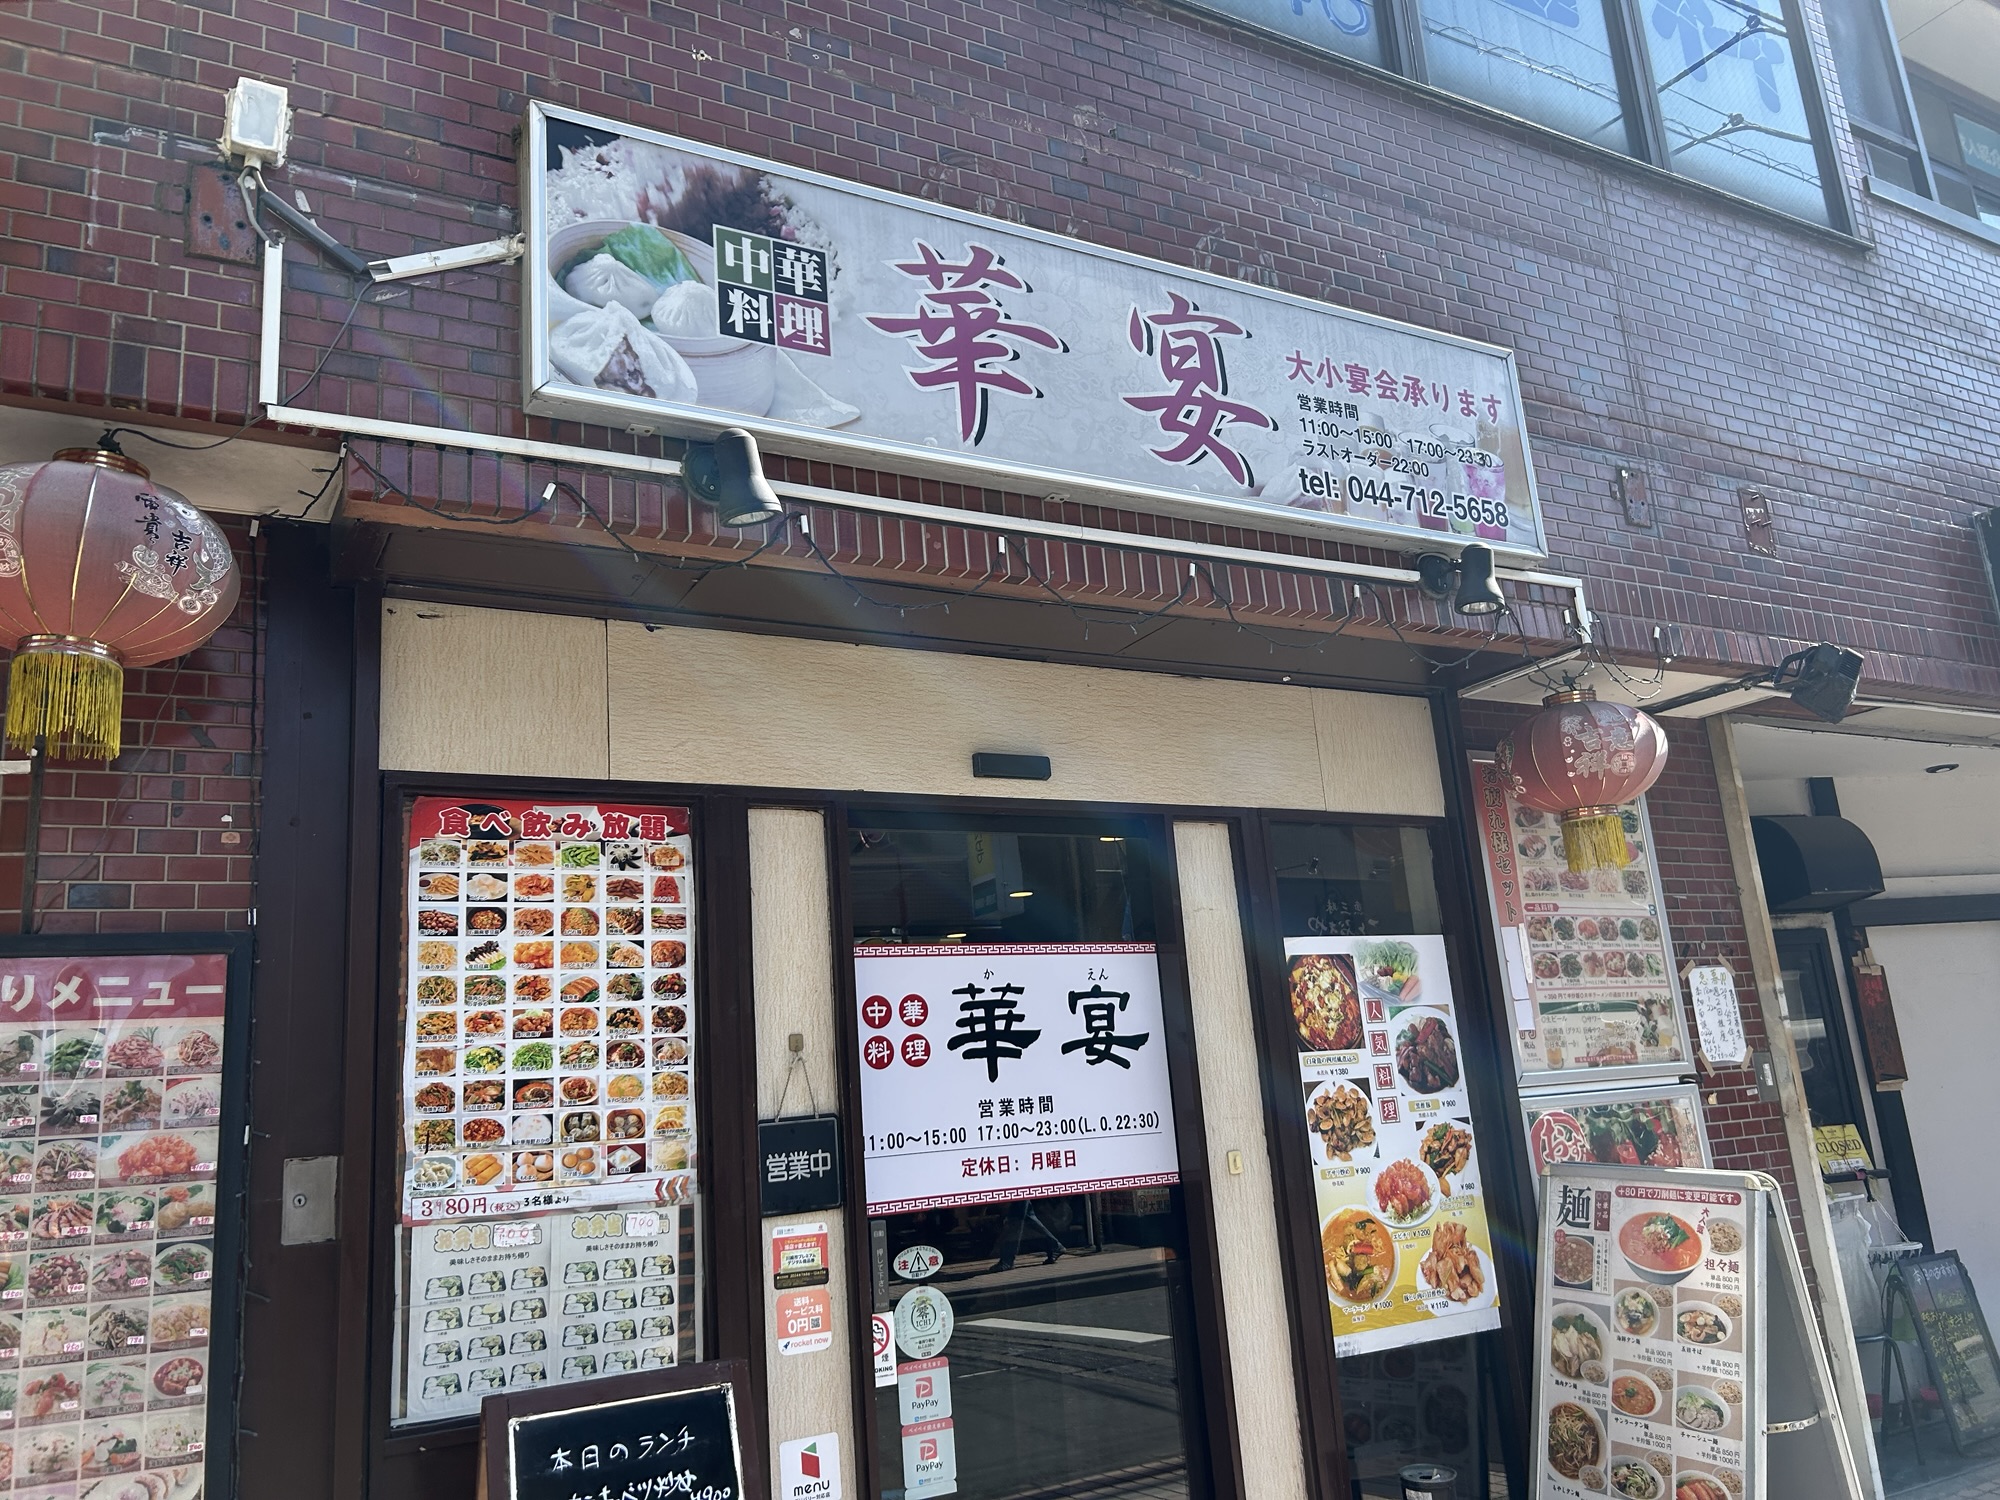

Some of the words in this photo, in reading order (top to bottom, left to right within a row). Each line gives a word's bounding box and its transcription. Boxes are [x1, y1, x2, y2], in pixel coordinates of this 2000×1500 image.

[725, 235, 823, 296] 中華
[726, 287, 825, 350] 料理
[1285, 350, 1503, 425] 大小宴会承ります
[1296, 393, 1360, 422] 営業時間
[1302, 439, 1429, 478] ラストオーダー22:00
[1299, 468, 1340, 499] tel:
[1348, 474, 1510, 528] 044-712-5658
[438, 806, 669, 842] 食べ飲み放題
[1481, 763, 1519, 924] お疲れ様セット
[1527, 903, 1554, 912] 一品料理
[983, 968, 995, 980] か
[1087, 968, 1109, 981] えん
[865, 999, 925, 1025] 中華
[867, 1038, 929, 1064] 料理
[1370, 1002, 1398, 1119] 人気料理
[1330, 1067, 1349, 1076] ¥1380
[978, 1094, 1055, 1119] 営業時間
[1442, 1100, 1456, 1108] ¥900
[1815, 1138, 1862, 1154] CLOSED
[766, 1149, 831, 1183] 営業中
[961, 1155, 1020, 1178] 定休日:
[1030, 1149, 1077, 1171] 月曜日
[1356, 1167, 1371, 1175] ¥900
[1461, 1182, 1475, 1191] ¥980
[1556, 1184, 1592, 1229] 麺
[1412, 1228, 1431, 1237] ¥1200
[586, 1240, 659, 1253] 美味しさそのままお持ち帰り
[449, 1251, 530, 1266] 美味しさそのままお持ち帰り
[784, 1303, 824, 1318] サービス料
[1374, 1300, 1393, 1310] ¥1000
[1430, 1300, 1449, 1310] ¥1150
[787, 1317, 809, 1334] 0円
[915, 1318, 932, 1328] ICHI
[790, 1338, 813, 1348] rocket
[813, 1337, 829, 1345] now
[911, 1398, 939, 1410] PayPay
[550, 1425, 696, 1472] 本日のランチ
[916, 1461, 944, 1473] PayPay
[793, 1479, 831, 1497] menu
